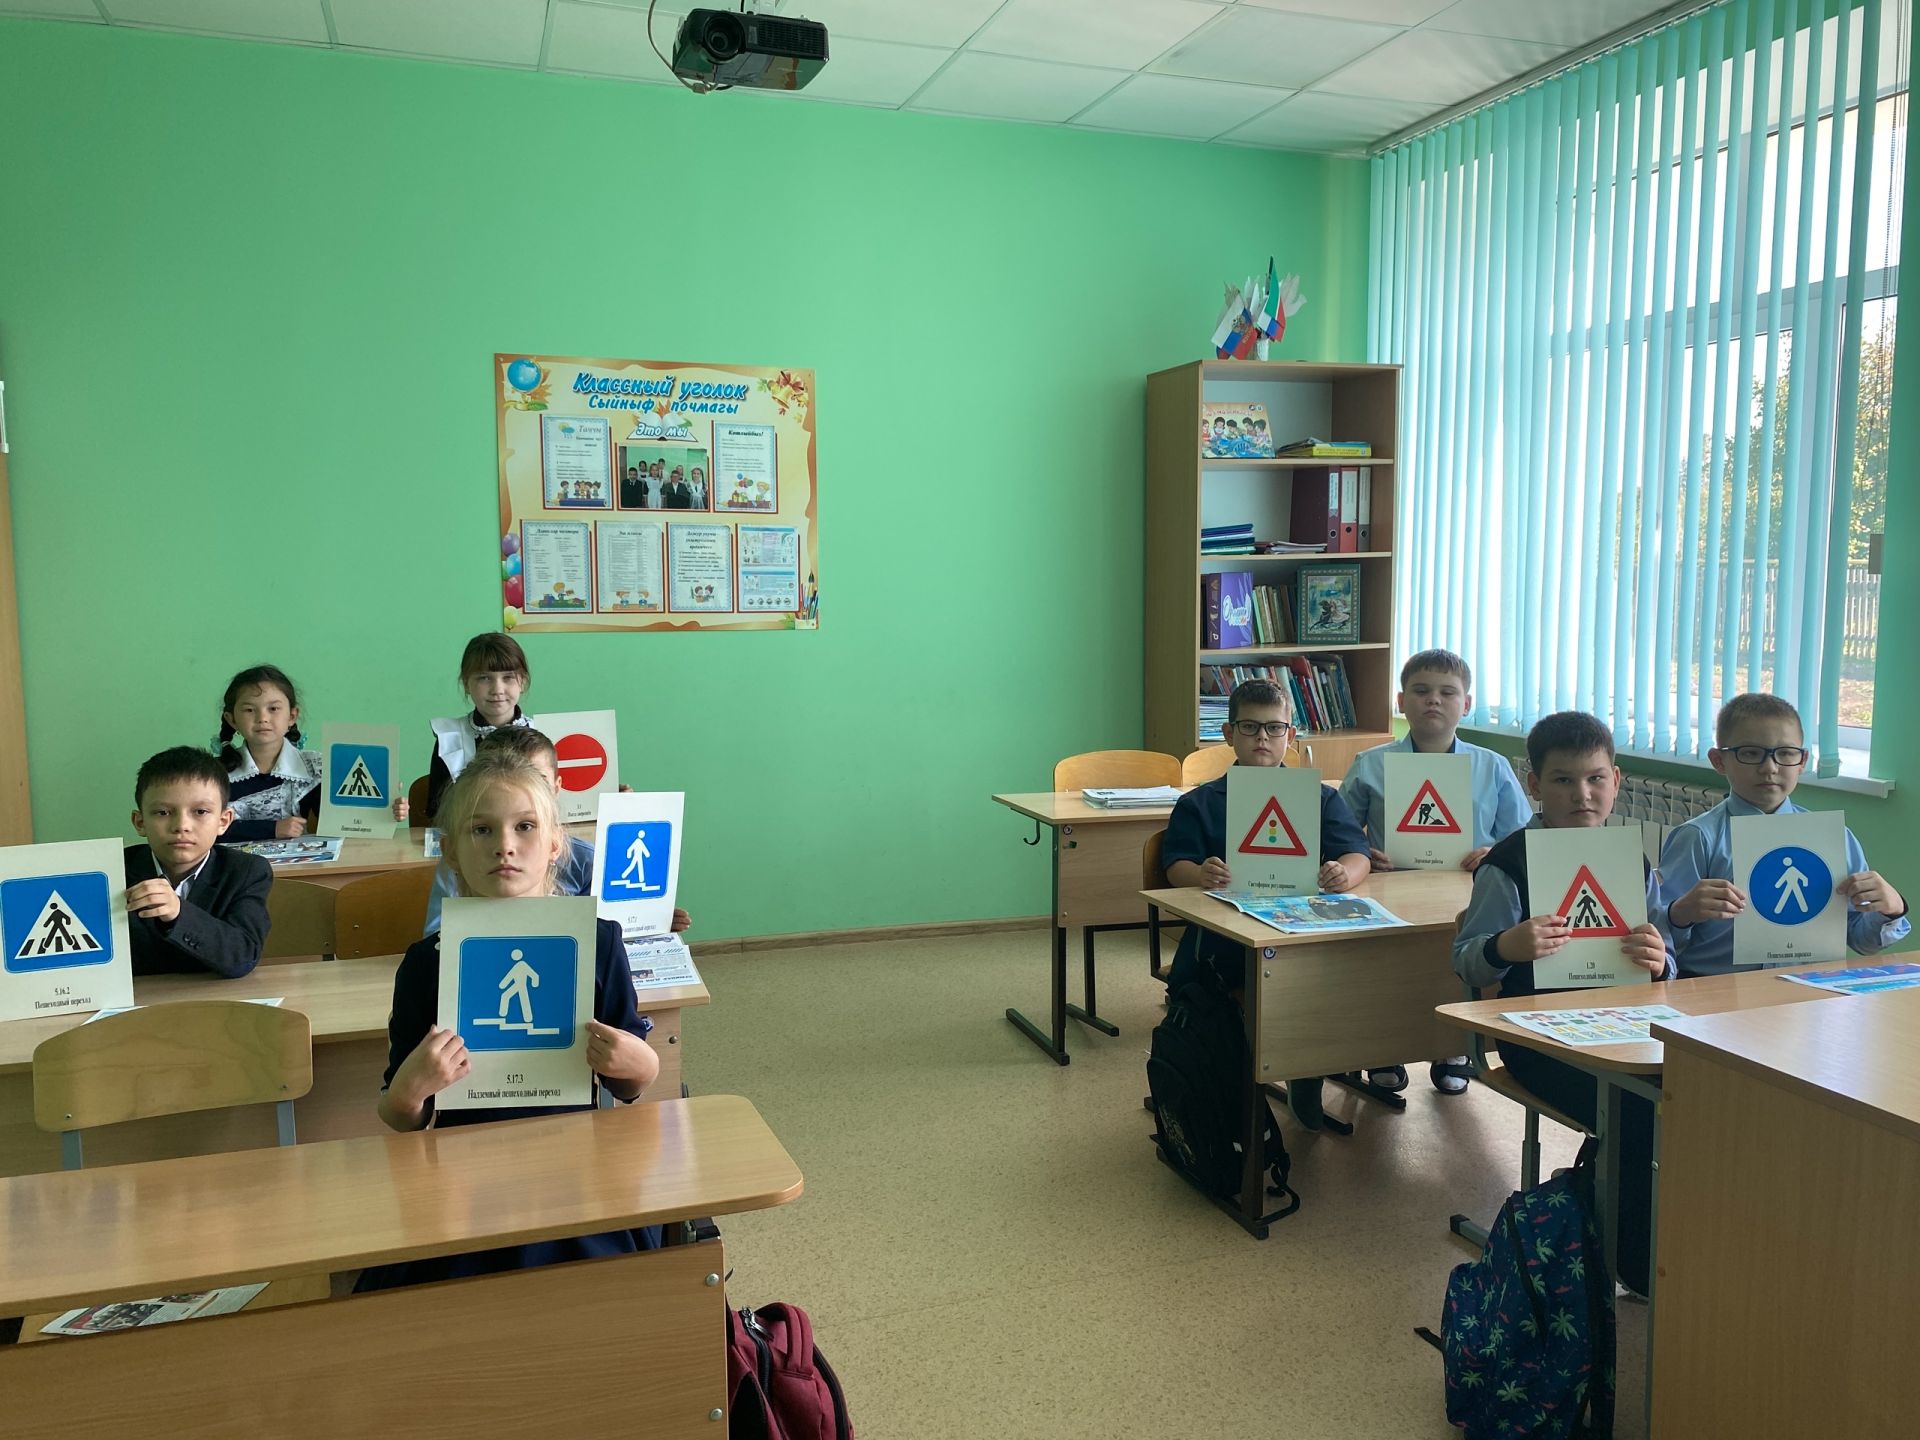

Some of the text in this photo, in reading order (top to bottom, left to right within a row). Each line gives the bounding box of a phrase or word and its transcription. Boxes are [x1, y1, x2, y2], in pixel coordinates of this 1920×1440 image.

[573, 372, 748, 400] Классный уголок
[589, 394, 739, 415] Сыйныф почмагы
[636, 423, 688, 437] Это мы
[1568, 972, 1615, 981] Пешеходный переход
[55, 987, 70, 995] 5.16.2
[35, 997, 92, 1009] Пешеходный переход
[506, 1074, 524, 1084] 5.17.3
[467, 1088, 561, 1099] Надземный пешеходный переход
